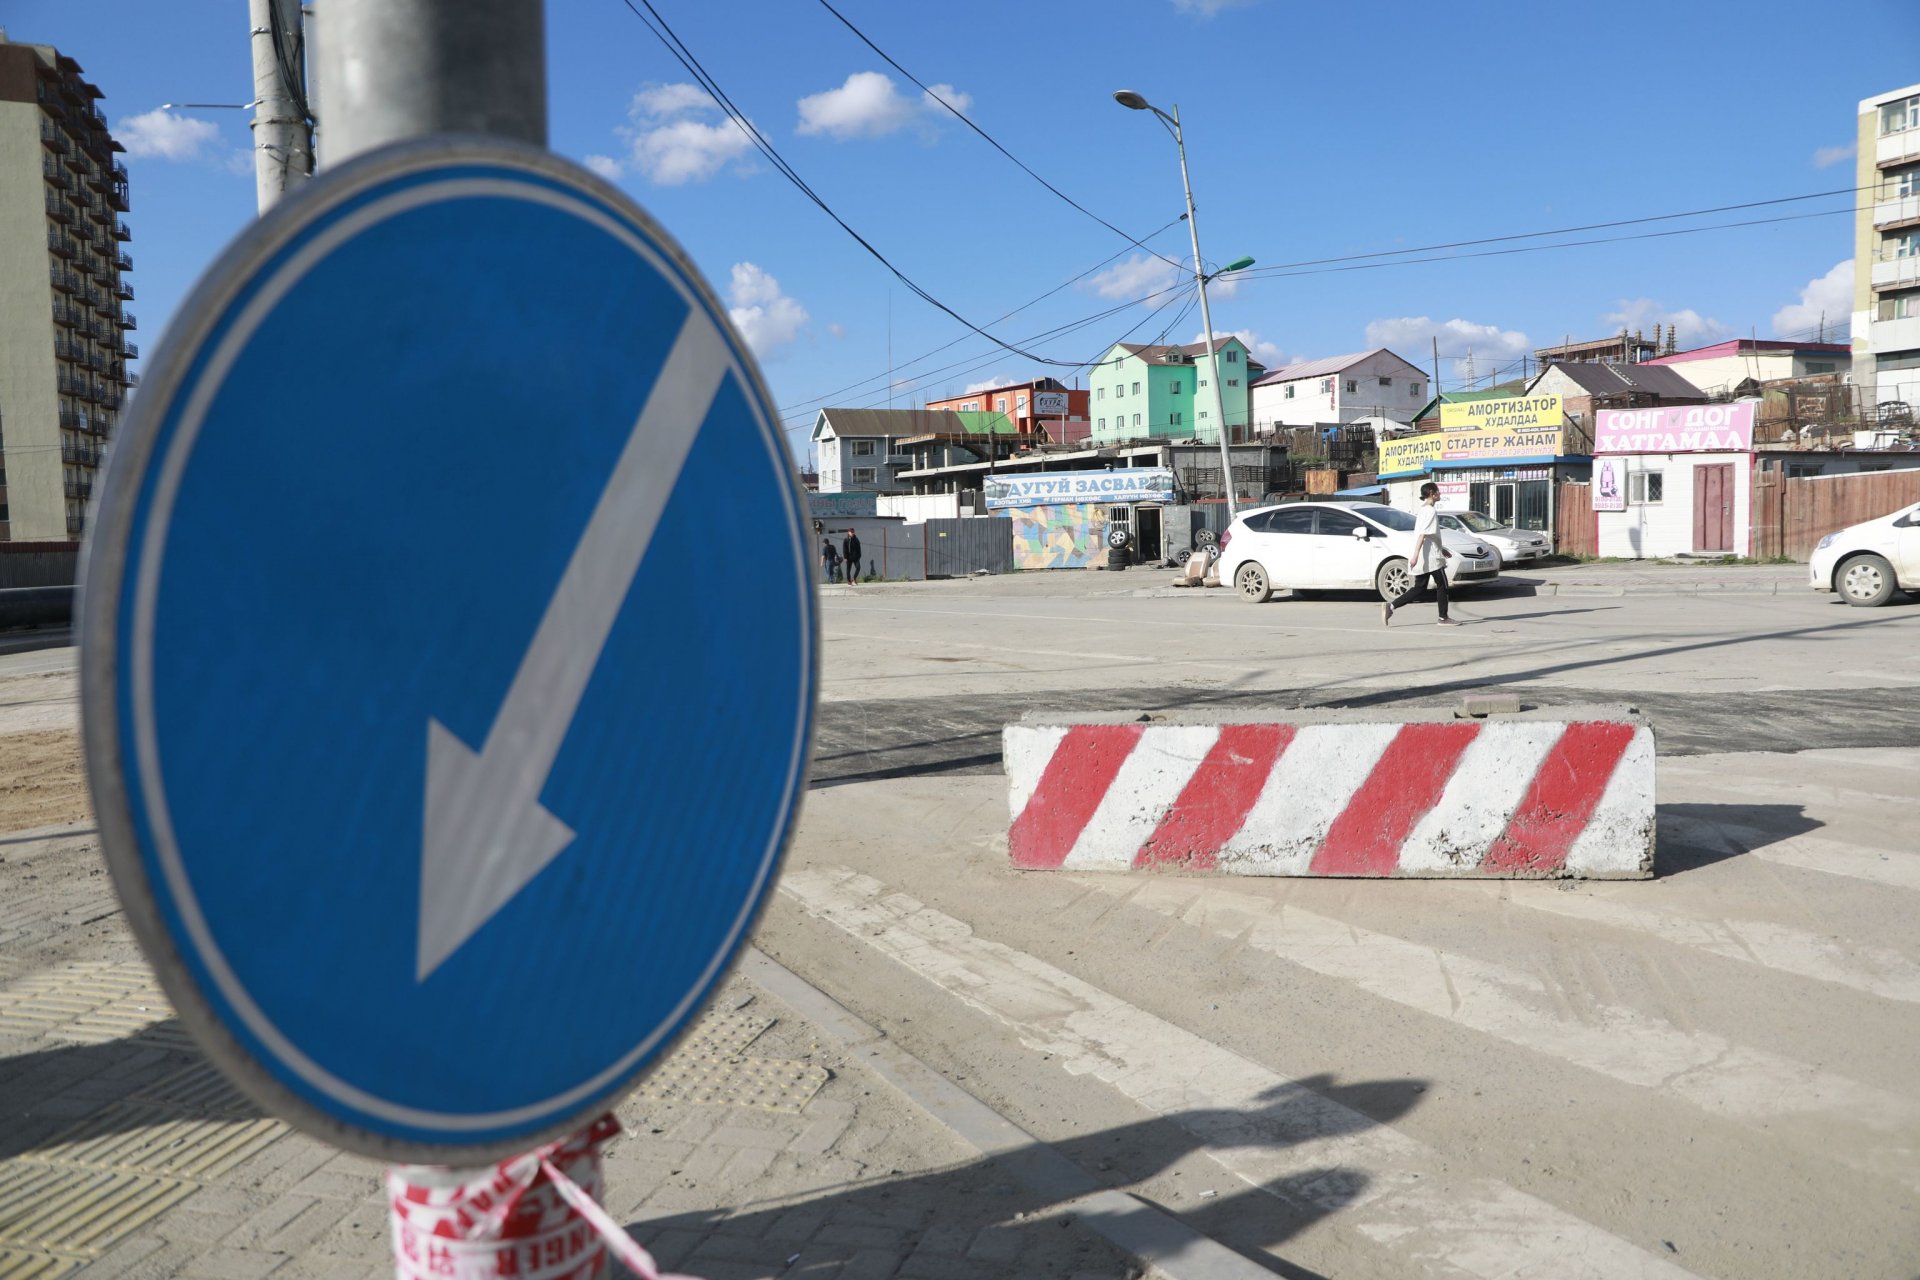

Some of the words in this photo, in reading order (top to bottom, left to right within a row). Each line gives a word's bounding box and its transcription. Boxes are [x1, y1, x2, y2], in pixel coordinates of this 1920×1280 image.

[1468, 397, 1557, 417] АМОРТИЗАТОР
[1485, 414, 1538, 428] ХУДАЛДАА
[1608, 411, 1664, 430] СОНГ
[1684, 407, 1738, 427] ДОГ
[1447, 436, 1499, 450] СТАРТЕР
[1503, 433, 1556, 447] ЖАНАМ
[1599, 430, 1745, 452] ХАТГАМАЛ
[1008, 478, 1071, 498] ДУГУЙ
[1076, 476, 1150, 493] ЗАСВАР
